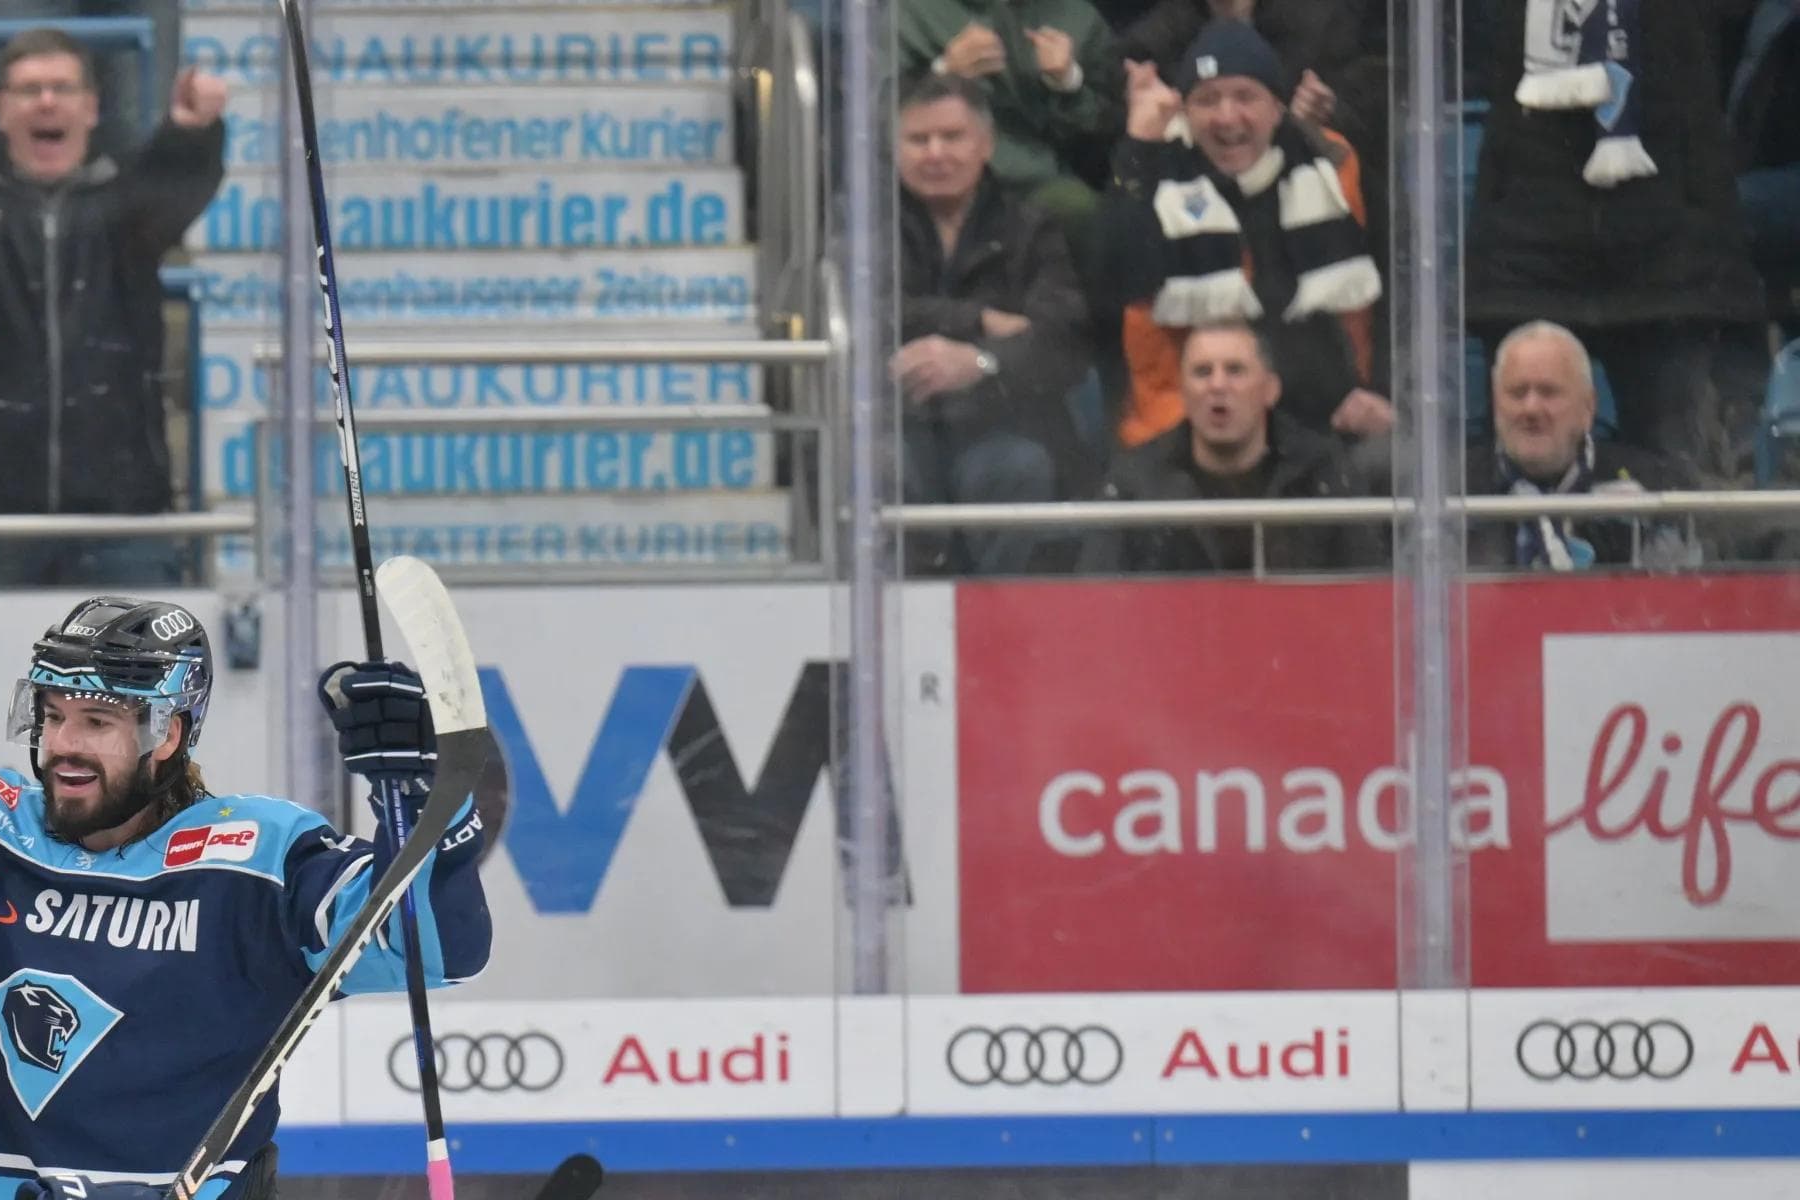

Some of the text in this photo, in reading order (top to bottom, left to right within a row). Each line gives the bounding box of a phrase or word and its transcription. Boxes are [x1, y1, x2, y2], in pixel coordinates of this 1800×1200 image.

[581, 108, 724, 160] Kurier
[1037, 728, 1511, 855] canada
[25, 888, 200, 952] SATURN
[602, 1032, 791, 1085] Audi
[1160, 1027, 1350, 1080] Audi
[1730, 1022, 1800, 1073] A
